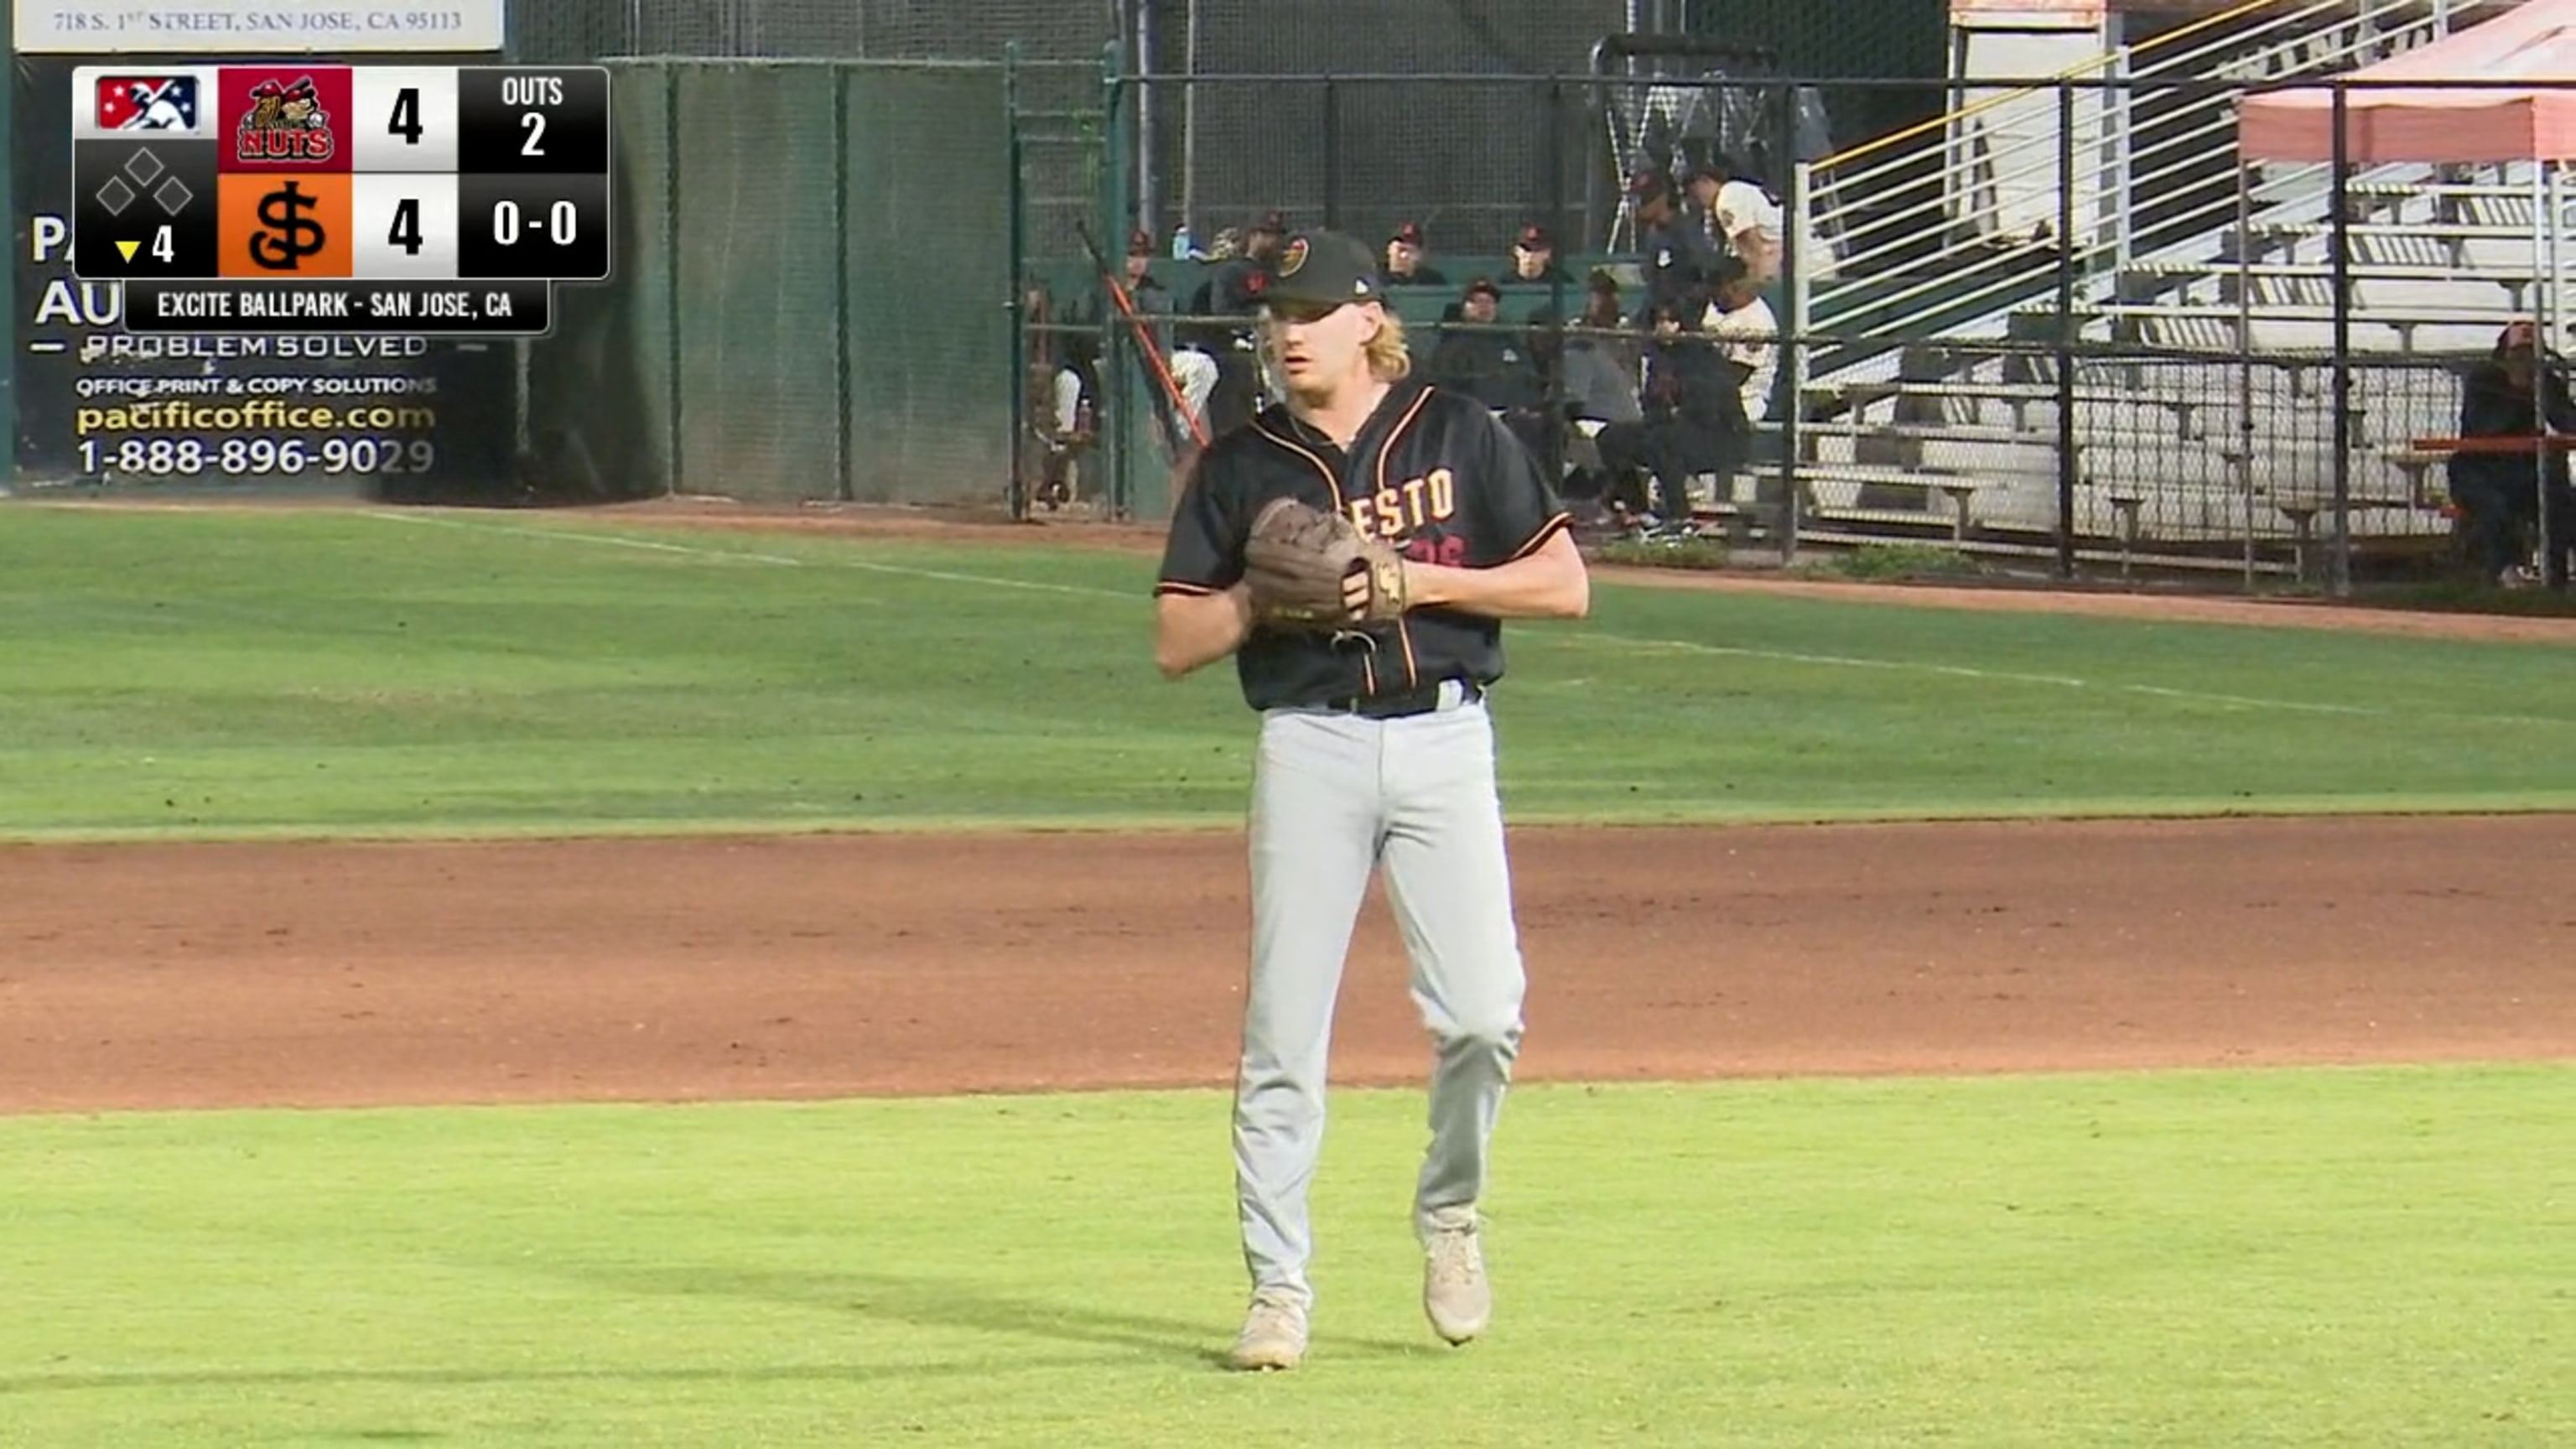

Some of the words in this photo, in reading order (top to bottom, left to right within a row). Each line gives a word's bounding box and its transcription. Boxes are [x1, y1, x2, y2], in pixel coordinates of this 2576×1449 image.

[54, 13, 86, 30] 718
[91, 13, 110, 30] S.
[148, 13, 241, 32] STREET,
[247, 13, 293, 30] SAN
[299, 13, 361, 31] JOSE,
[367, 13, 399, 30] CA
[405, 13, 461, 30] 95113
[86, 335, 267, 357] PROBLEM
[277, 335, 428, 356] SOLVED
[158, 378, 222, 393] PRINT
[226, 378, 243, 393] &
[247, 378, 310, 393] COPY
[312, 377, 438, 393] SOLUTIONS
[77, 400, 435, 435] pacificoffice.com
[78, 439, 434, 474] 1-888-896-9029
